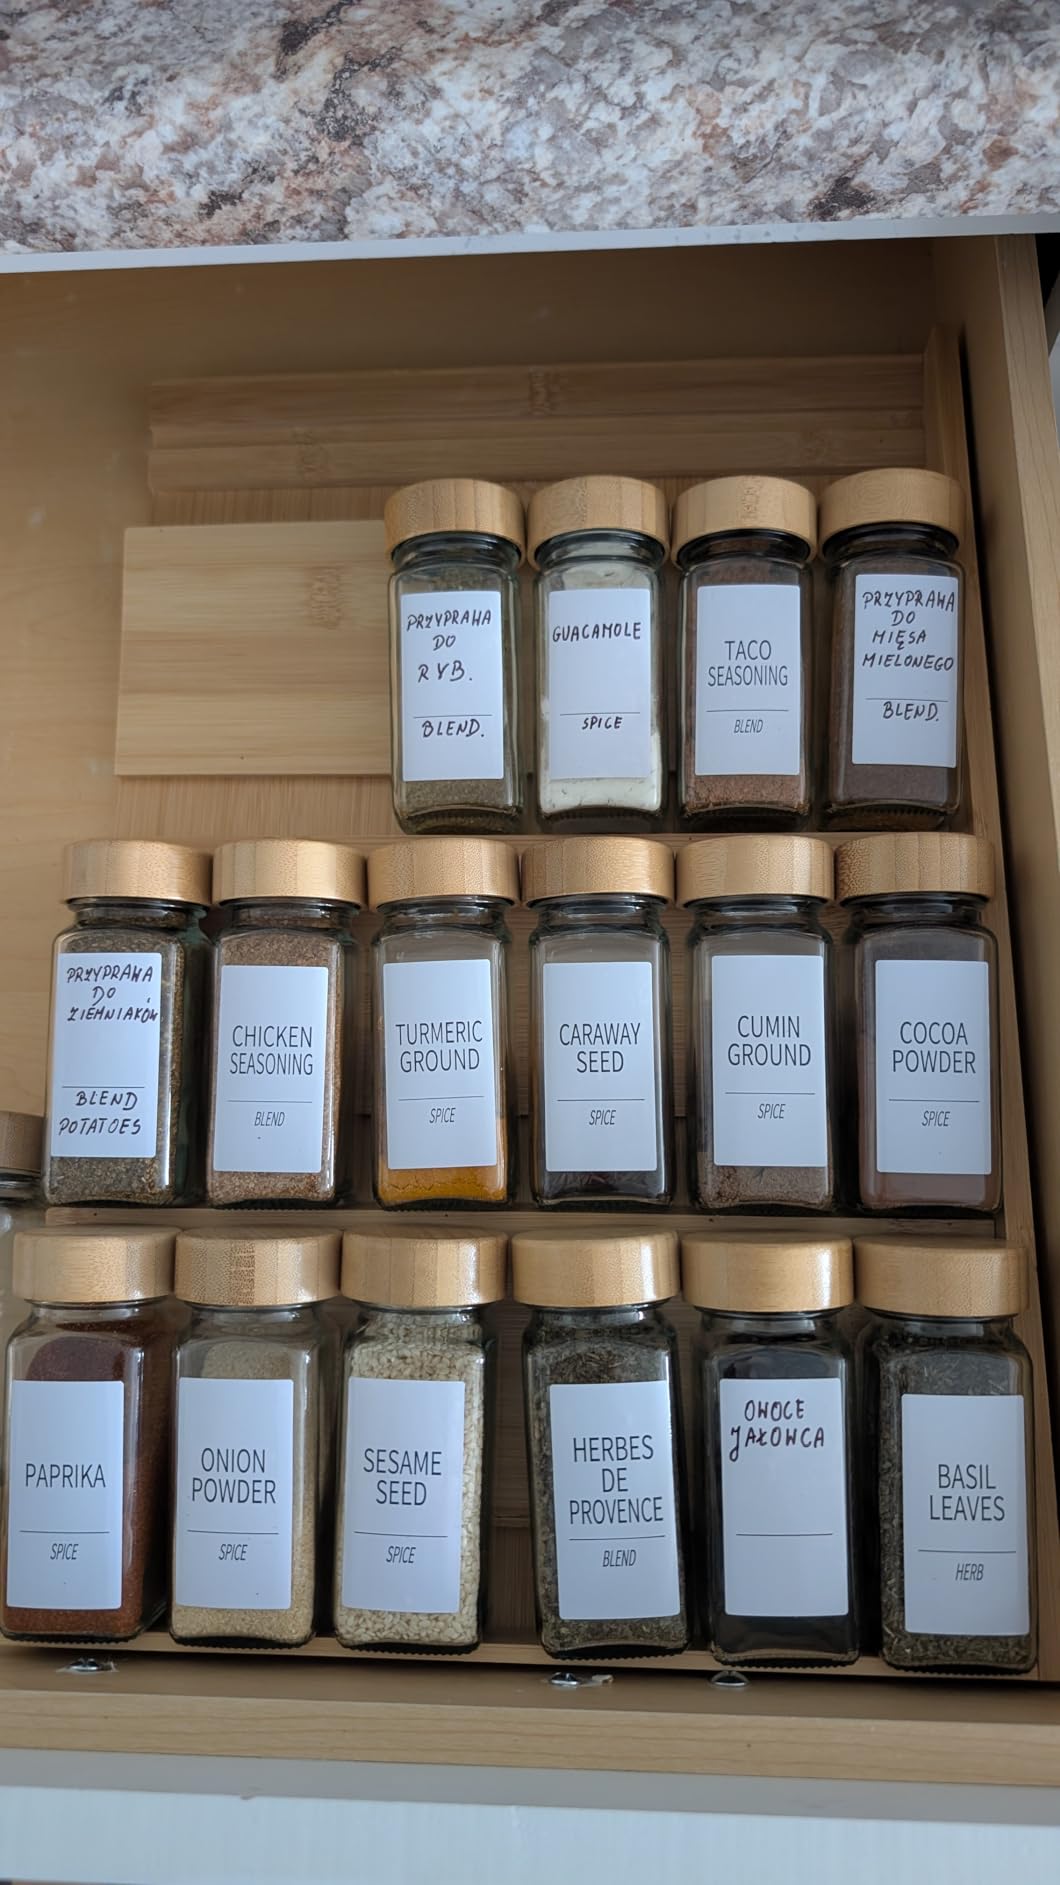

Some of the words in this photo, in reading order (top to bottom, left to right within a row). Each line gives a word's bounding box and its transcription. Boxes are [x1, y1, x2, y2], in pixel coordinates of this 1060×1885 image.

[891, 610, 915, 626] DO
[432, 634, 457, 651] DO
[552, 621, 642, 643] GUACAMOLE
[872, 630, 927, 650] MIĘSA
[724, 639, 772, 661] TACO
[417, 659, 473, 683] RYB.
[862, 652, 954, 671] MIELONEGO
[707, 664, 788, 687] SEASONING
[882, 701, 940, 722] BLEND.
[421, 718, 485, 739] BLEND.
[581, 716, 623, 730] SPICE
[733, 719, 764, 734] BLEND
[92, 986, 116, 1006] DO
[232, 1025, 313, 1048] CHICKEN
[395, 1020, 484, 1046] TURMERIC
[559, 1022, 641, 1046] CARAWAY
[737, 1015, 800, 1038] CUMIN
[900, 1021, 968, 1045] COCOA
[229, 1052, 314, 1076] SEASONING
[400, 1048, 480, 1073] GROUND
[576, 1050, 624, 1073] SEED
[727, 1043, 811, 1066] GROUND
[892, 1049, 976, 1074] POWDER
[76, 1091, 138, 1111] BLEND
[757, 1103, 786, 1119] SPICE
[59, 1117, 142, 1136] POTATOES
[254, 1111, 285, 1127] BLEND
[429, 1107, 456, 1124] SPICE
[589, 1109, 616, 1126] SPICE
[921, 1110, 951, 1127] SPICE
[744, 1399, 804, 1421] OWOCE
[573, 1435, 653, 1462] HERBES
[729, 1426, 824, 1462] JAŁOWCA
[201, 1447, 266, 1473] ONION
[363, 1448, 442, 1476] SESAME
[25, 1463, 106, 1489] PAPRIKA
[601, 1467, 629, 1492] DE
[937, 1463, 997, 1490] BASIL
[191, 1477, 277, 1504] POWDER
[375, 1480, 427, 1506] SEED
[569, 1497, 663, 1524] PROVENCE
[929, 1495, 1005, 1521] LEAVES
[50, 1543, 79, 1561] SPICE
[218, 1543, 248, 1561] SPICE
[386, 1545, 416, 1564] SPICE
[602, 1549, 636, 1567] BLEND
[955, 1562, 984, 1581] HERB
